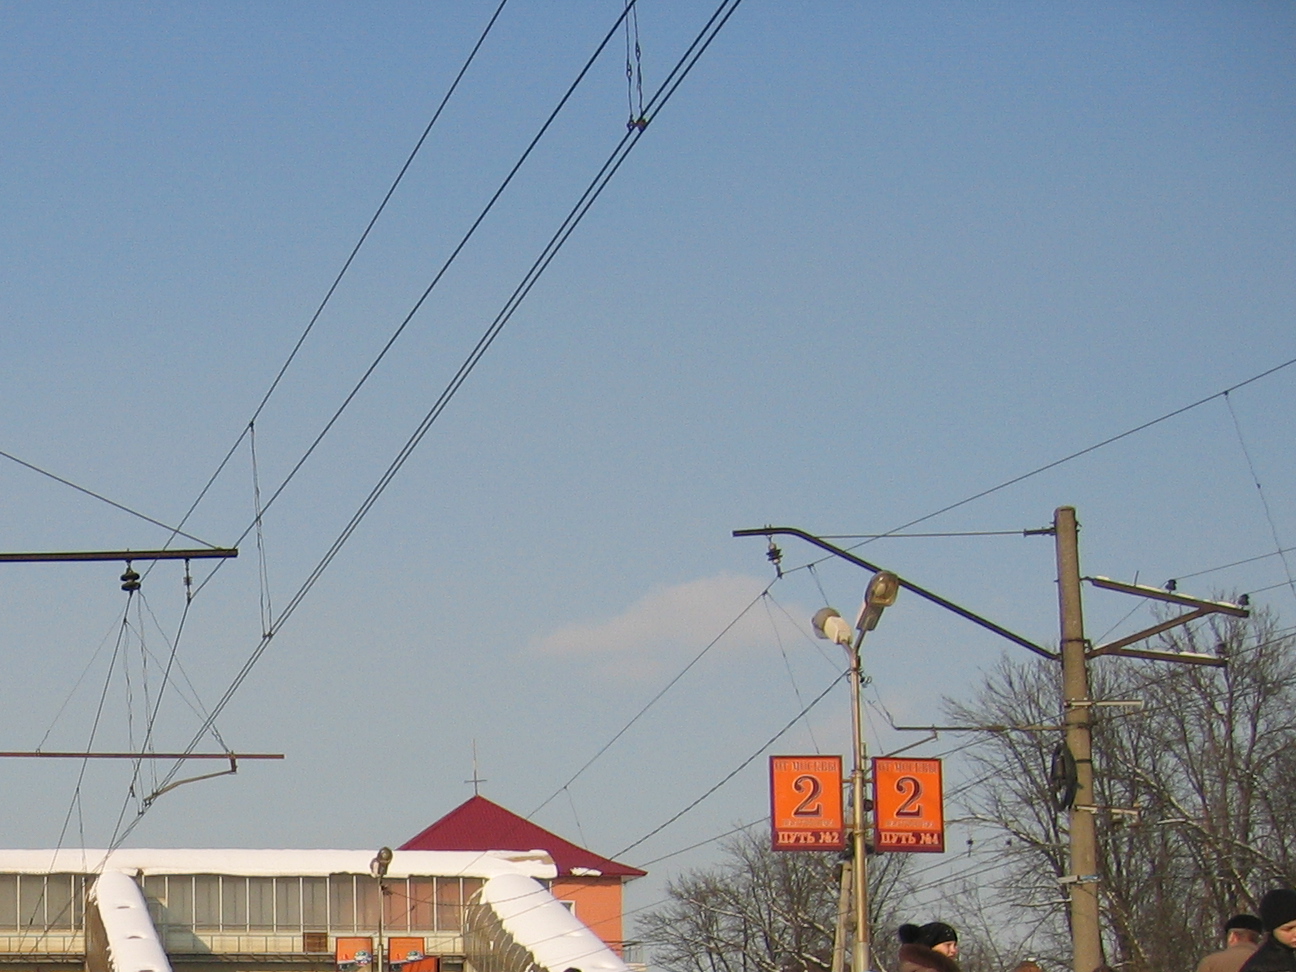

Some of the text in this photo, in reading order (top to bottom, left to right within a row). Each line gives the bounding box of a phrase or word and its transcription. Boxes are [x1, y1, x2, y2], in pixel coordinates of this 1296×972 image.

[791, 773, 823, 818] 2
[893, 774, 924, 819] 2
[778, 832, 840, 844] ПУТЬ №2
[880, 832, 916, 844] ПУТЬ
